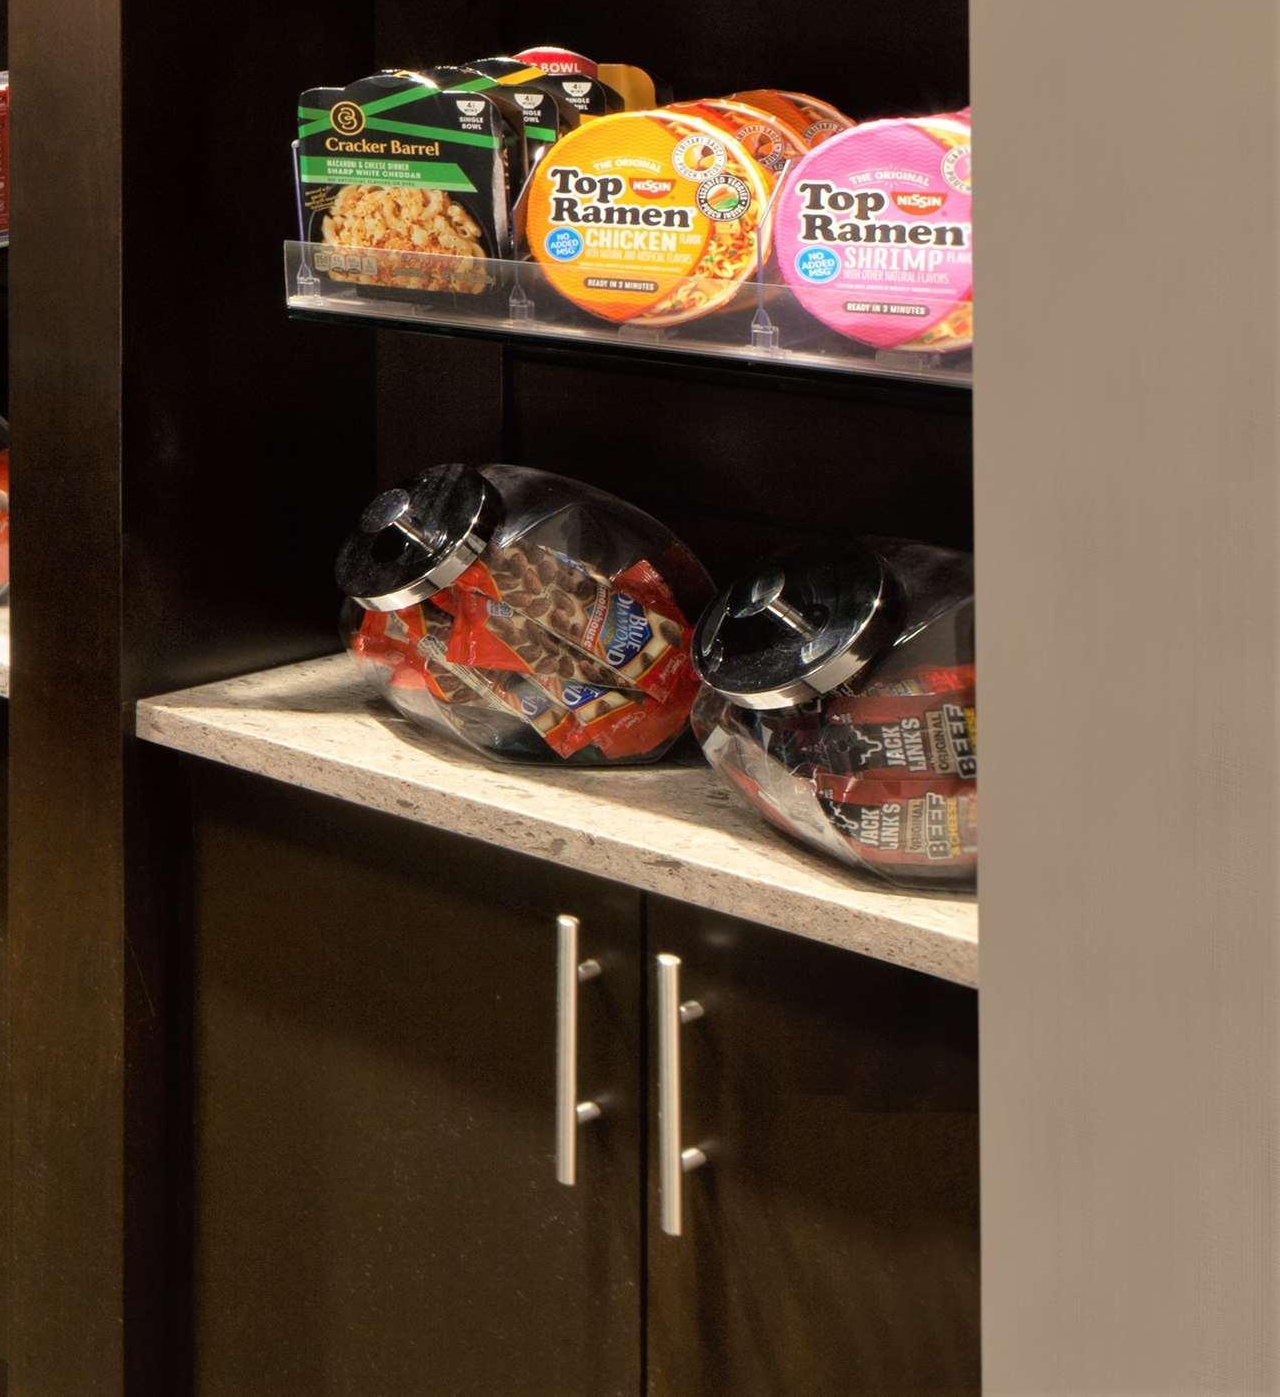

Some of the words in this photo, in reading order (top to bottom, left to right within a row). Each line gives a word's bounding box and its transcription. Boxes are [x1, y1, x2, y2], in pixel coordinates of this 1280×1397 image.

[541, 62, 582, 74] BOWL
[459, 116, 484, 124] SINGLE
[325, 137, 387, 154] Cracker
[391, 139, 440, 156] Barrel
[356, 169, 381, 177] WHITE
[382, 171, 421, 179] CHEDDAR
[593, 161, 613, 172] THE
[614, 158, 662, 173] ORIGINAL
[551, 168, 623, 203] Top
[632, 180, 672, 193] NISSIN
[849, 174, 872, 186] THE
[875, 171, 930, 187] ORIGINAL
[799, 183, 886, 220] Top
[896, 194, 942, 208] NISSIN
[551, 197, 691, 229] Ramen
[585, 228, 677, 252] CHICKEN
[801, 213, 966, 247] Ramen
[550, 239, 579, 250] ADDED
[801, 259, 836, 270] ADDED
[807, 252, 825, 261] NO
[844, 247, 944, 271] SHRIMP
[808, 267, 832, 277] MSG
[862, 270, 884, 281] OTHER
[885, 270, 916, 283] NATURAL
[918, 271, 950, 284] FLAVORS
[587, 278, 608, 288] READY
[609, 280, 617, 288] IN
[624, 280, 655, 291] MINUTES
[847, 302, 870, 312] READY
[872, 304, 881, 313] IN
[882, 304, 889, 313] 3
[890, 305, 926, 316] MINUTES
[583, 584, 609, 649] mokehouse
[605, 591, 634, 667] DIAMOND
[625, 613, 648, 653] BLUE
[881, 725, 908, 767] JACK
[900, 716, 927, 772] LINK'S
[944, 704, 977, 778] BEEF
[859, 807, 881, 846] JACK
[880, 802, 901, 851] LINK'S
[926, 792, 952, 860] BEEF
